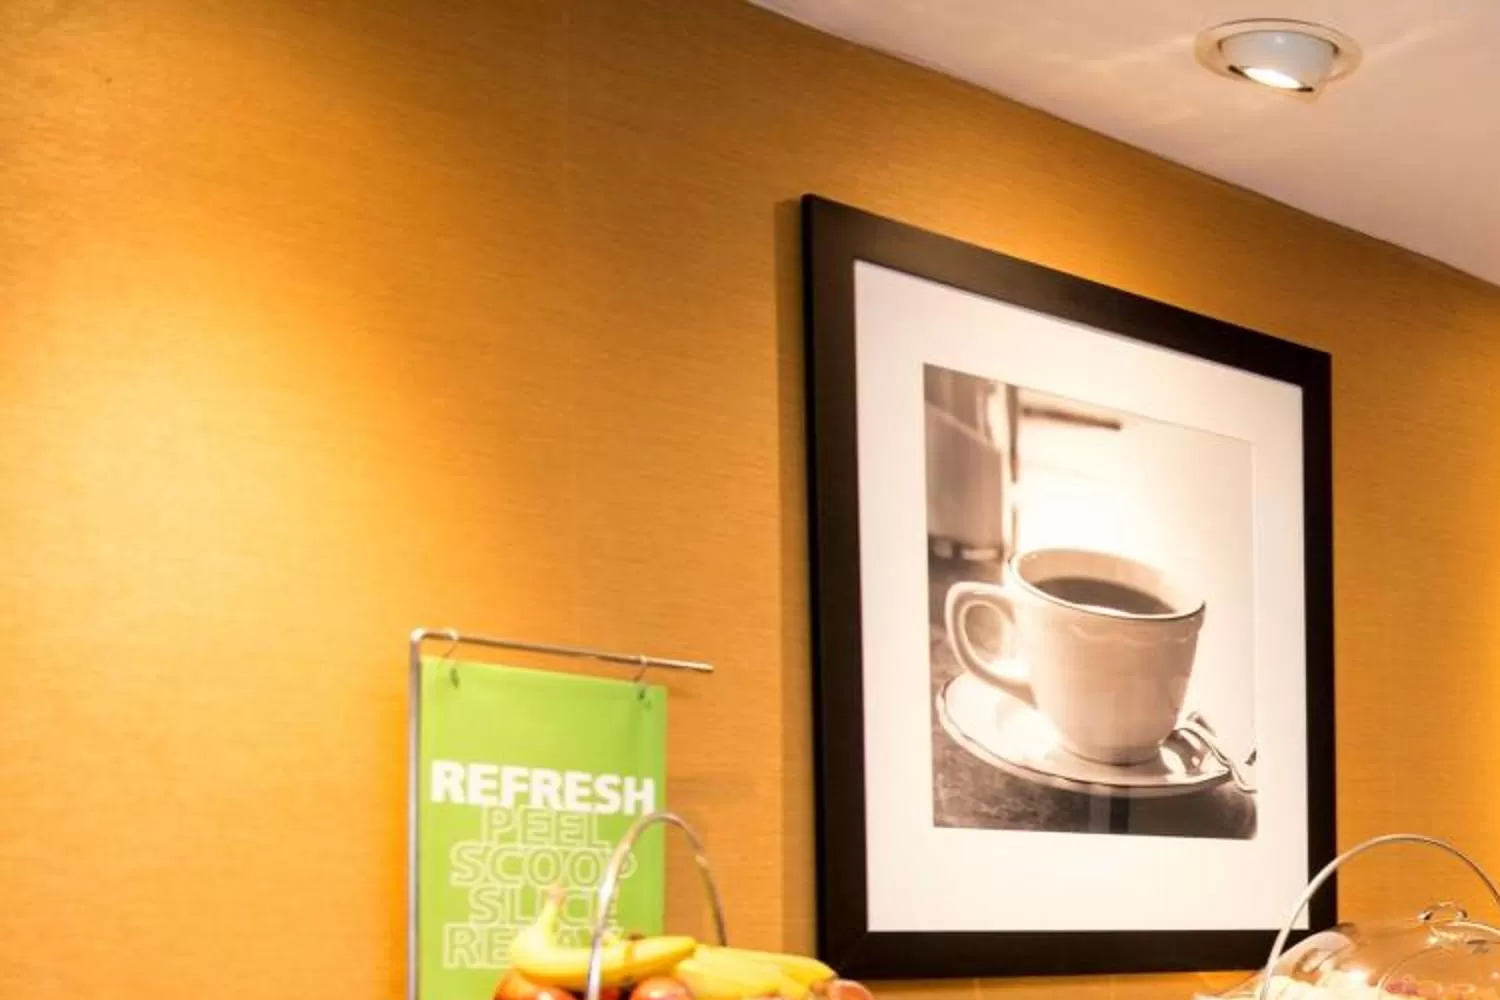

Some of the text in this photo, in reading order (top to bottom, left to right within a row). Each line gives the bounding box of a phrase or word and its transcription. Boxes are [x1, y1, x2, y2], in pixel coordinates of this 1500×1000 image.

[431, 759, 656, 817] REFRESH
[481, 803, 613, 850] PEEL
[449, 839, 638, 888] SCOOP
